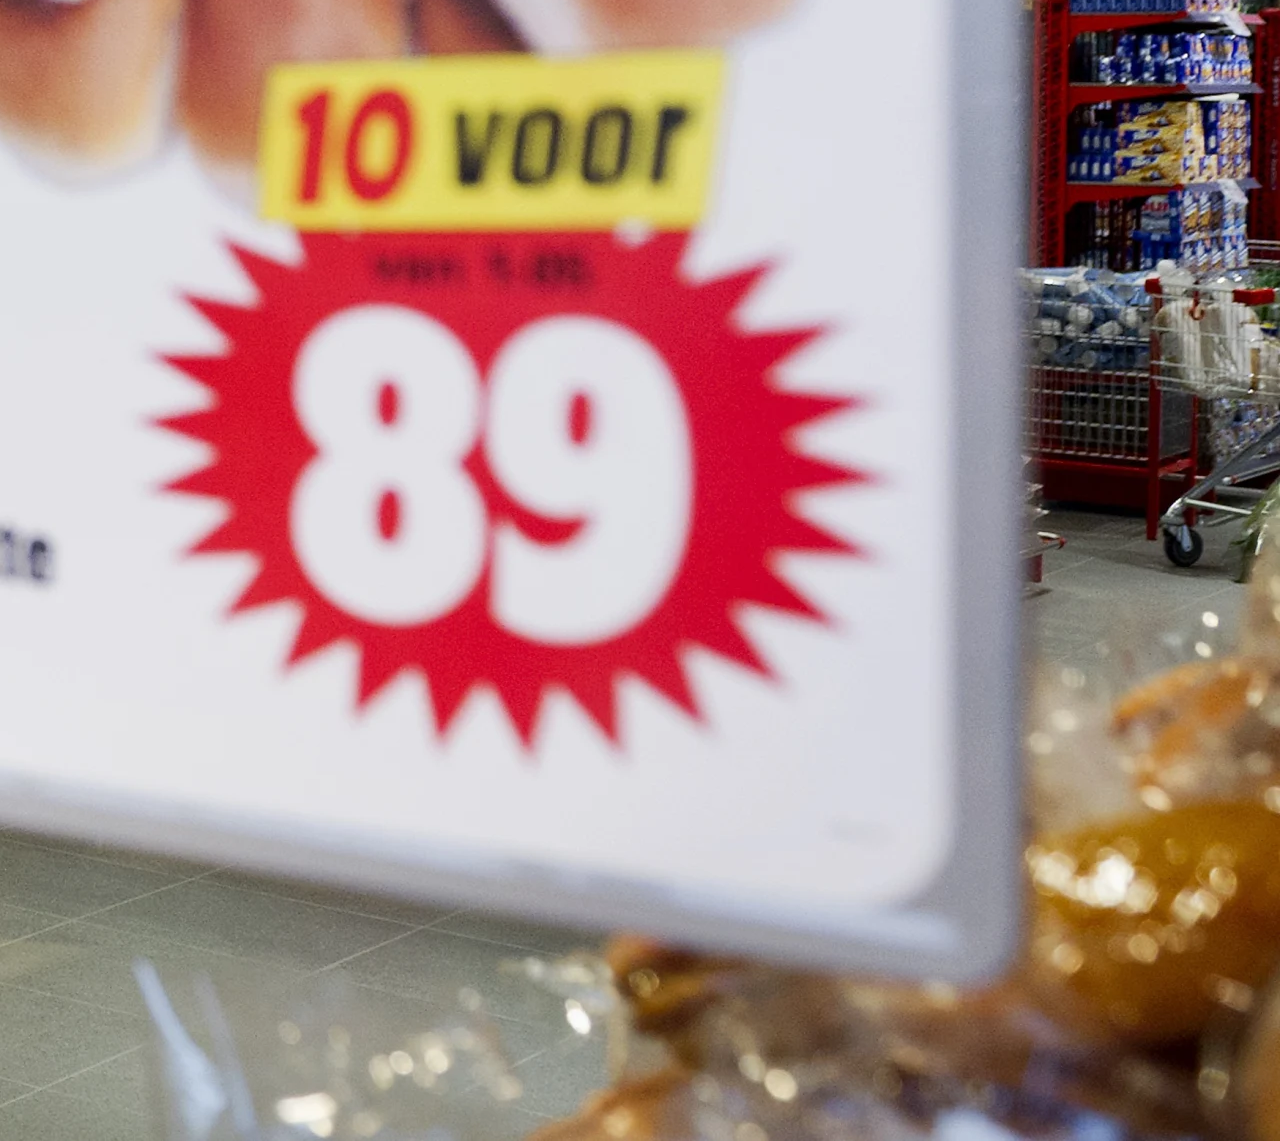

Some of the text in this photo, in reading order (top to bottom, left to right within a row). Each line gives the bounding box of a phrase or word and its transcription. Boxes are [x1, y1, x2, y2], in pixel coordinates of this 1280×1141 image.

[297, 87, 691, 205] 10 voor
[289, 302, 695, 647] 89
